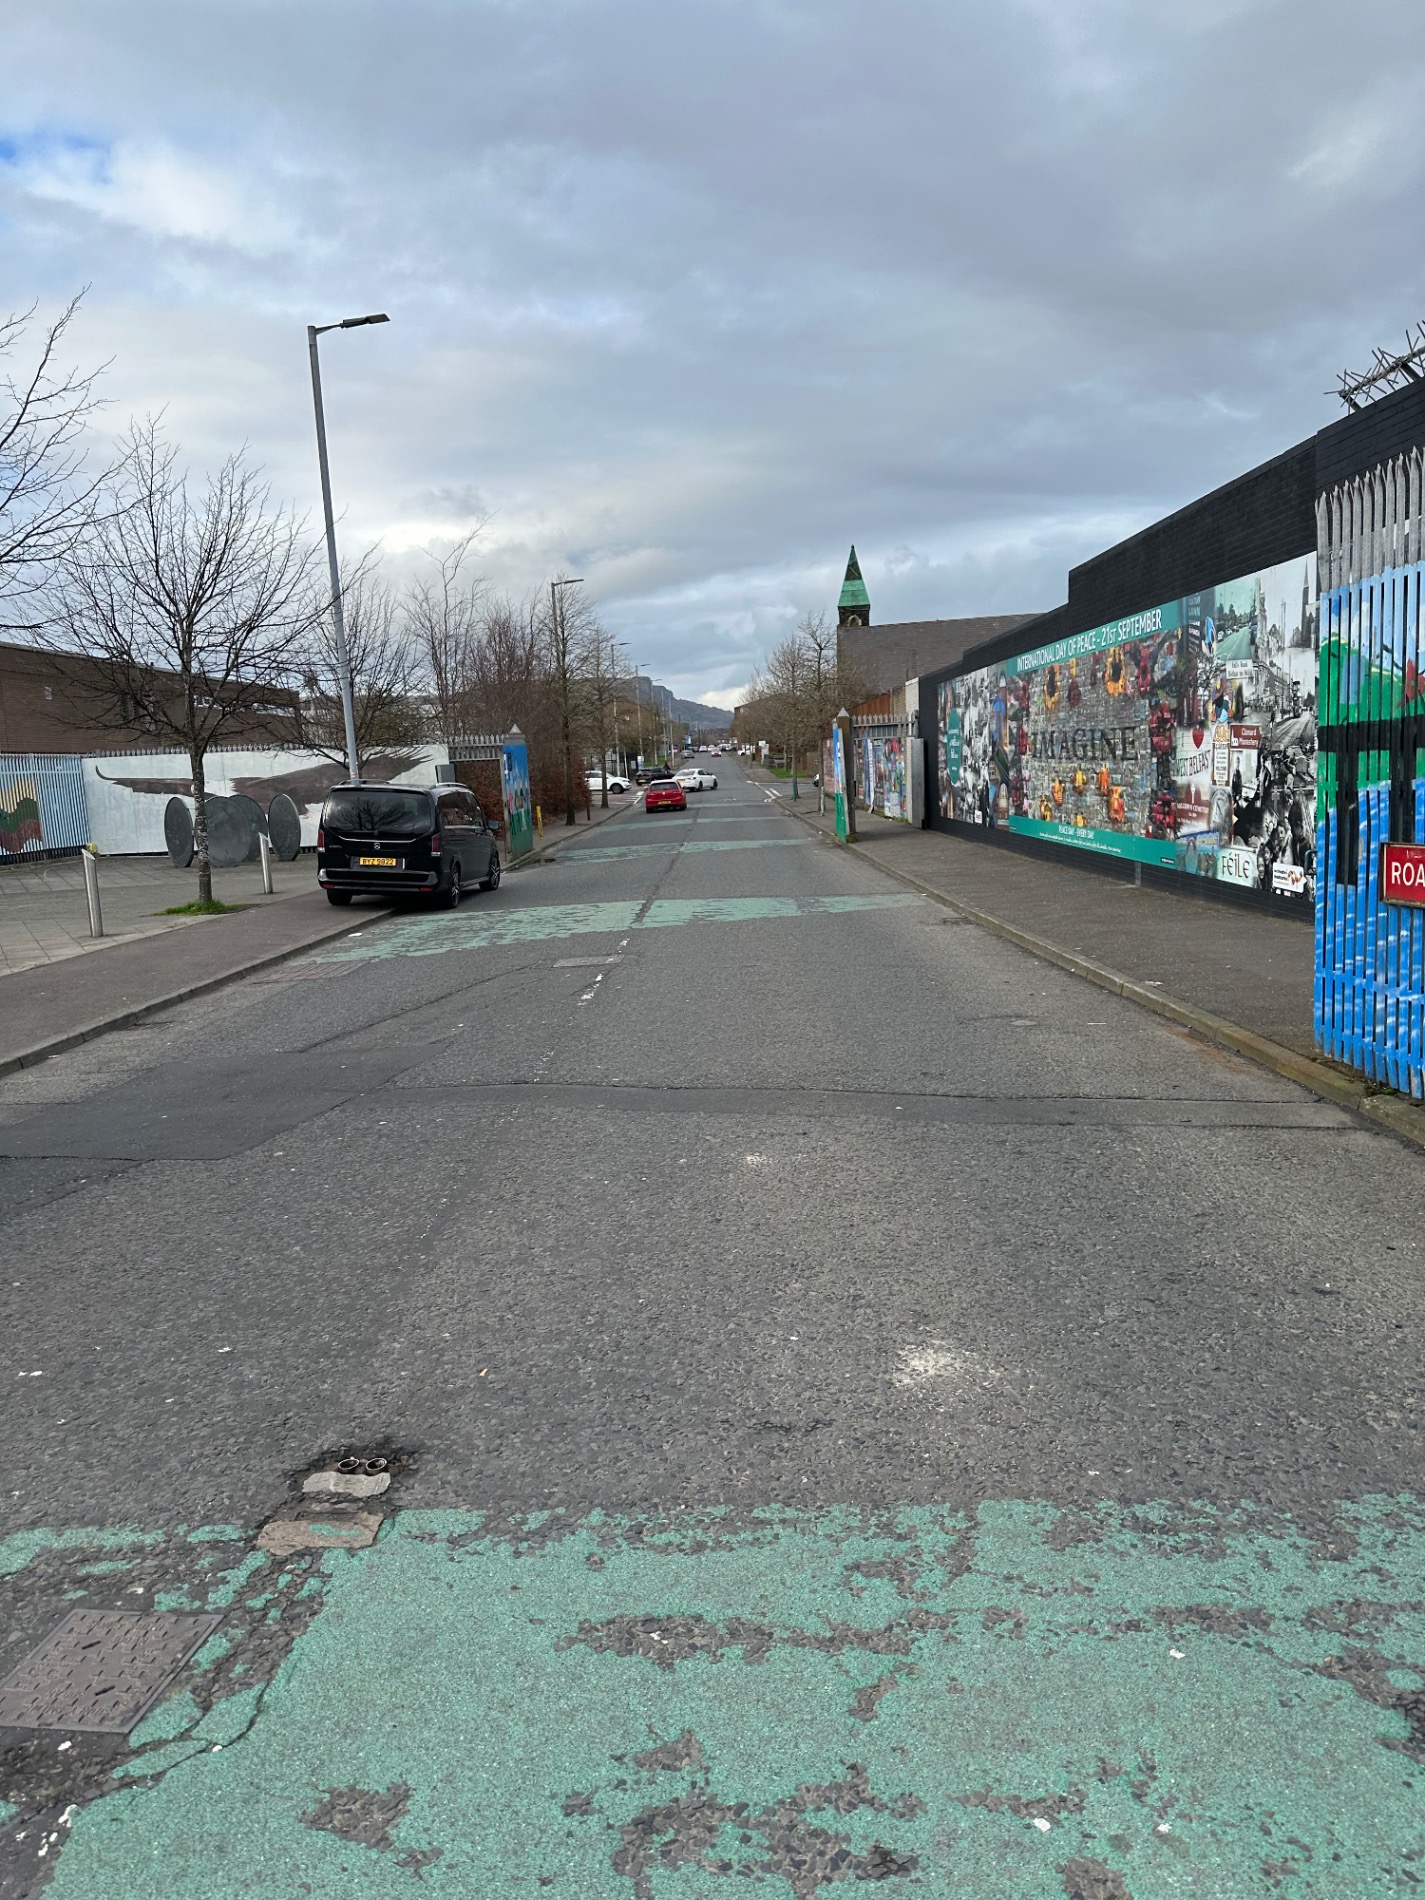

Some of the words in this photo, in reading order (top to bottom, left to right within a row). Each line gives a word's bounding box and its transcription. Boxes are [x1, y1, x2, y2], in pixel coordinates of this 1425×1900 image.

[1017, 646, 1055, 672] INTERNATIONAL
[1056, 642, 1067, 659] DAY
[1068, 638, 1076, 656] OF
[1077, 632, 1096, 653] PEACE
[1118, 608, 1162, 641] SEPTEMBER
[1031, 726, 1139, 760] IMAGINE
[1239, 737, 1259, 748] Monastery
[1189, 749, 1211, 776] BELFAST
